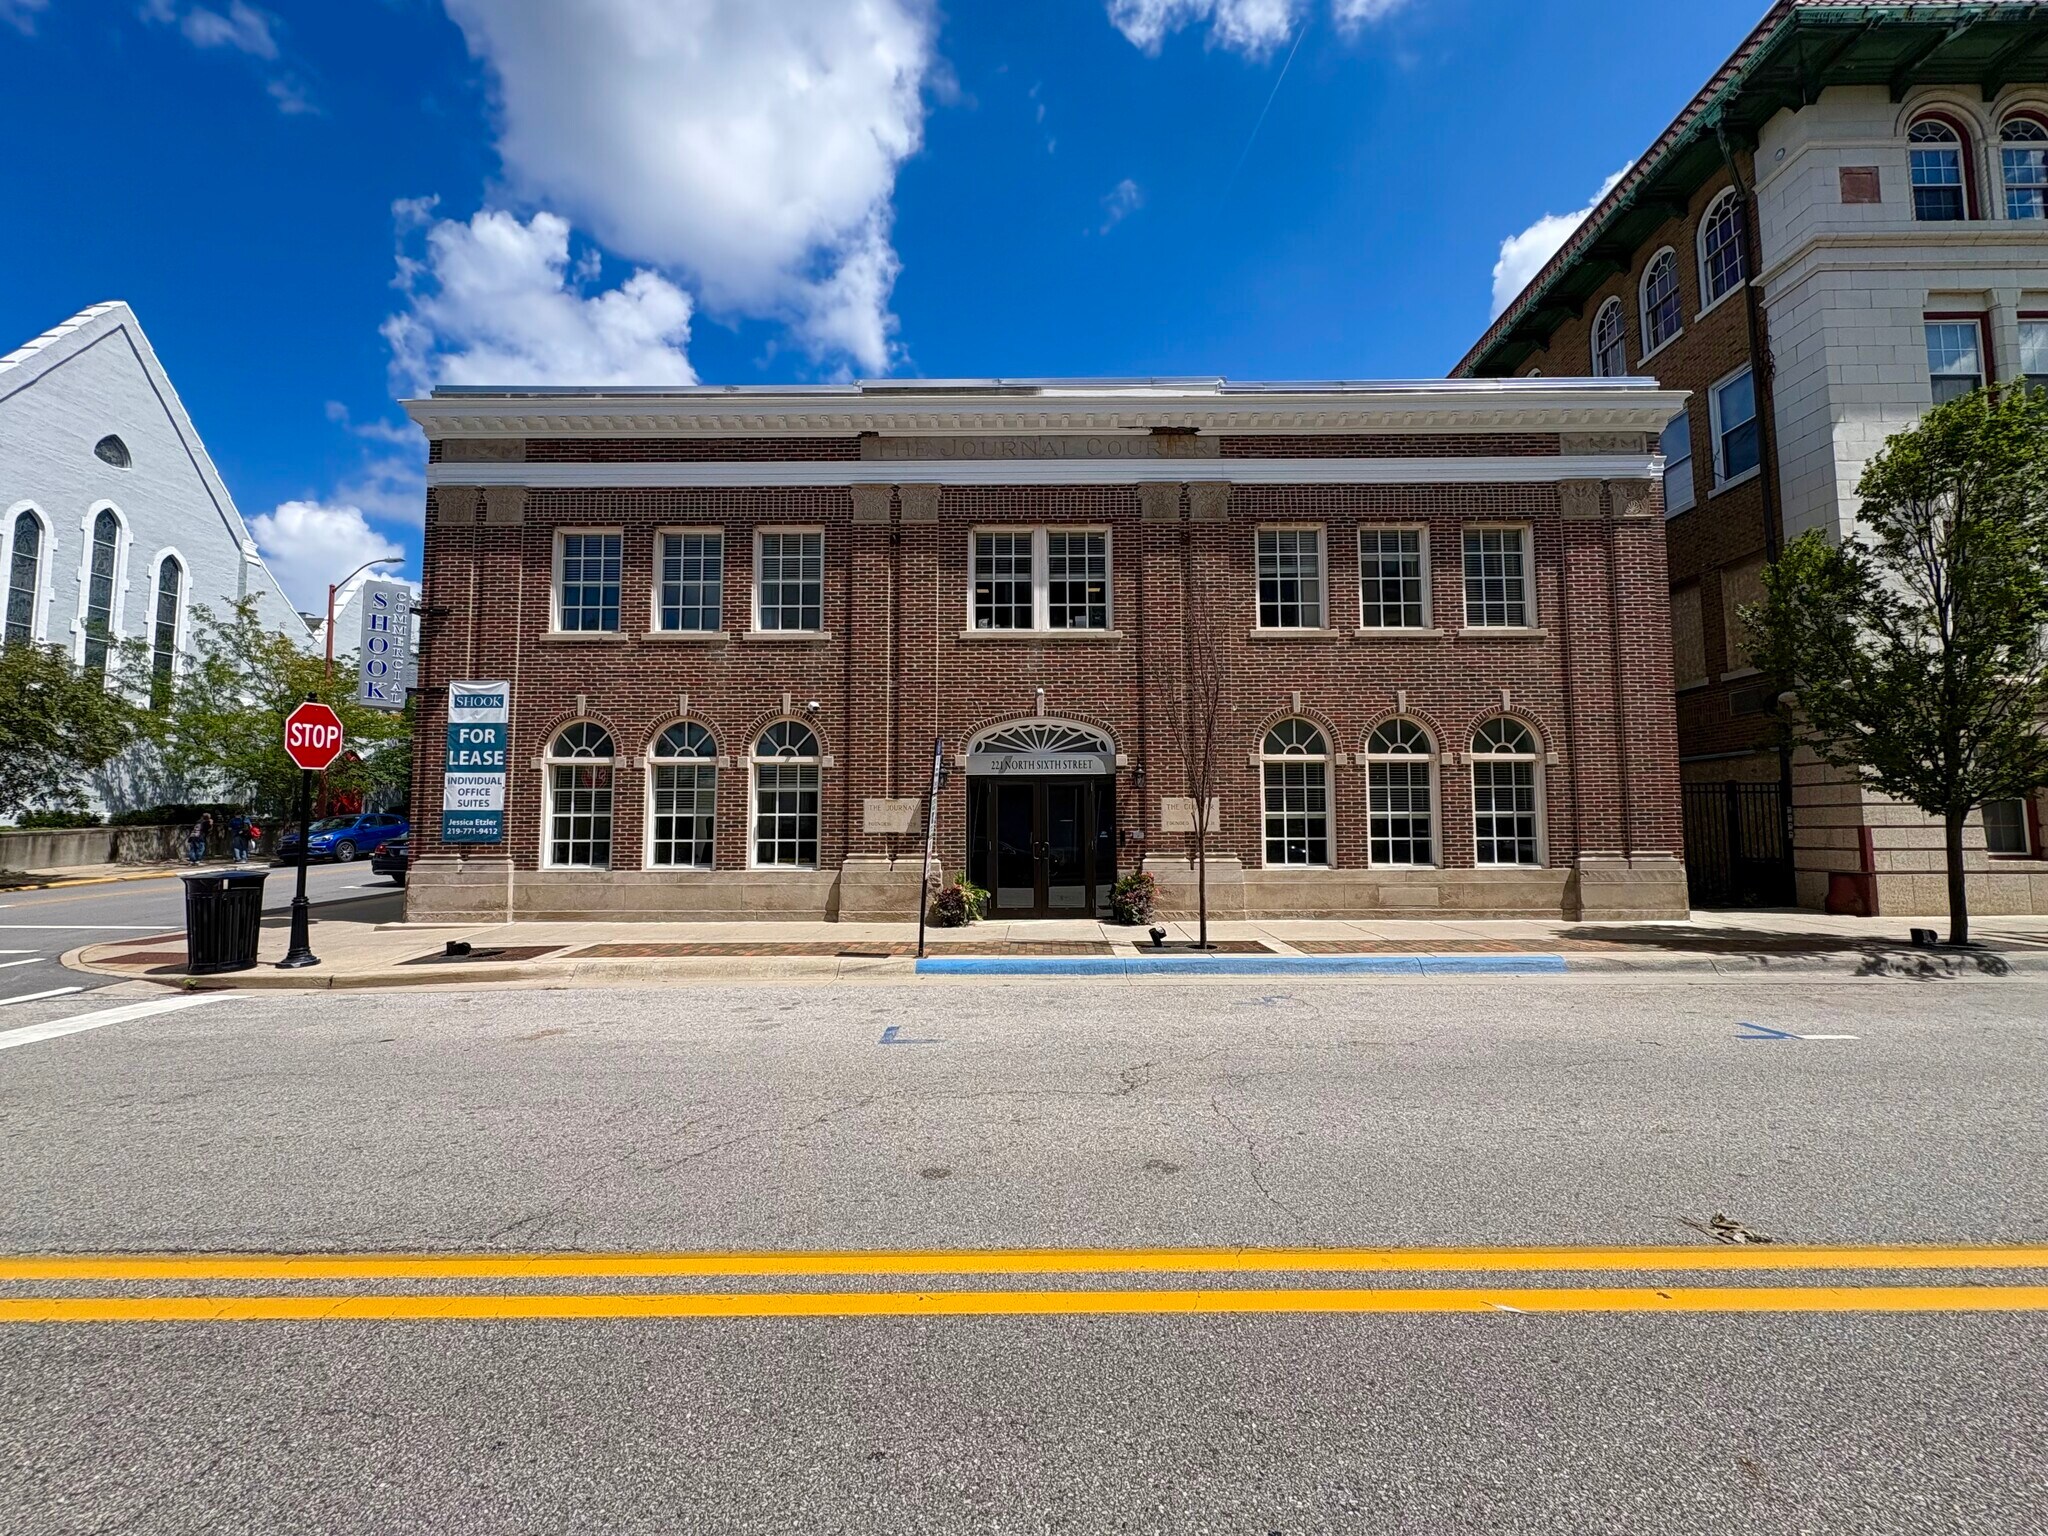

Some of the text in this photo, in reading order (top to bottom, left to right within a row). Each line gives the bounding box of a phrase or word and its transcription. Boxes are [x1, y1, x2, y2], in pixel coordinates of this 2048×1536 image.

[872, 437, 1208, 457] THE JOURNAL COURIER
[364, 591, 391, 700] SHOOK
[390, 591, 408, 703] COMMERCIAL
[456, 696, 502, 707] SHOOK
[290, 722, 339, 749] STOP
[459, 728, 496, 744] FOR
[448, 750, 504, 766] LEASE
[991, 759, 1093, 770] 221 NORTH SIXTH STREET
[447, 776, 503, 785] INDIVIDUAL
[457, 787, 491, 797] OFFICE
[457, 799, 490, 808] SUITES
[868, 804, 881, 812] THE
[1166, 803, 1180, 811] THE
[448, 818, 497, 827] Jessica Etzler
[446, 827, 498, 835] 219-771-9412
